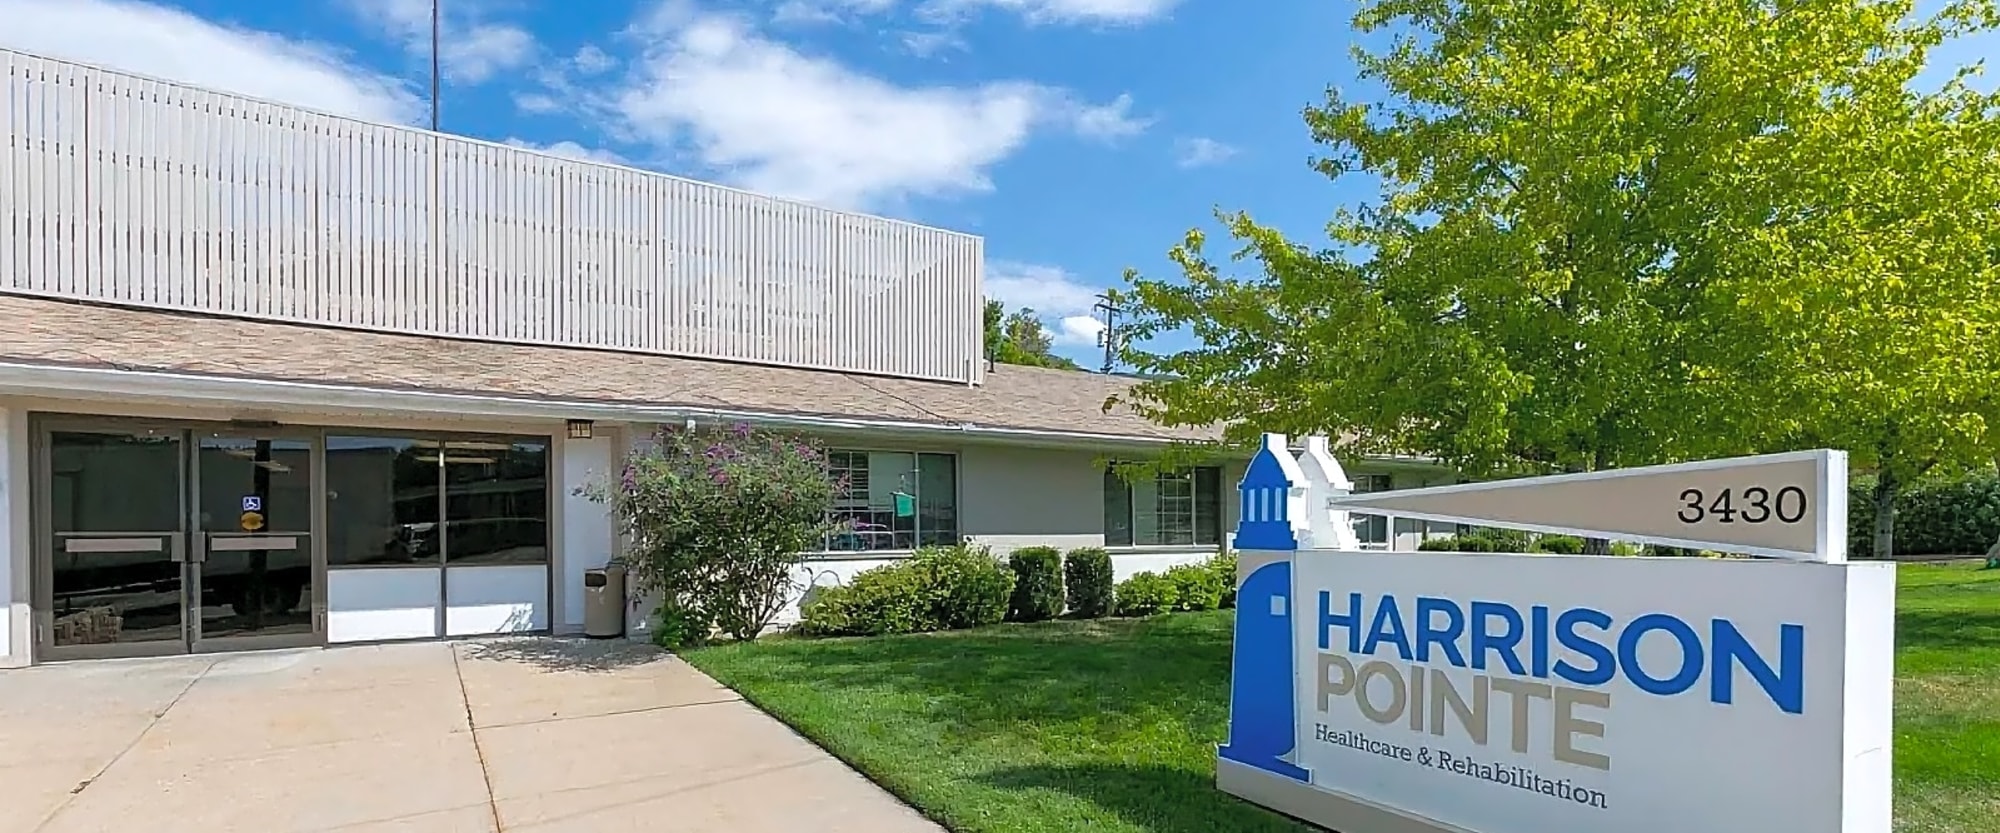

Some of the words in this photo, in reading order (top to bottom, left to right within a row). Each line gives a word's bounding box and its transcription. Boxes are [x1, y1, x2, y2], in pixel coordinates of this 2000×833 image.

[1677, 485, 1808, 524] 3430
[1318, 590, 1804, 714] HARRISON
[1317, 653, 1610, 770] POINTE
[1315, 723, 1413, 763] Healthcare
[1416, 746, 1434, 768] &
[1438, 750, 1608, 809] Rehabilitation
